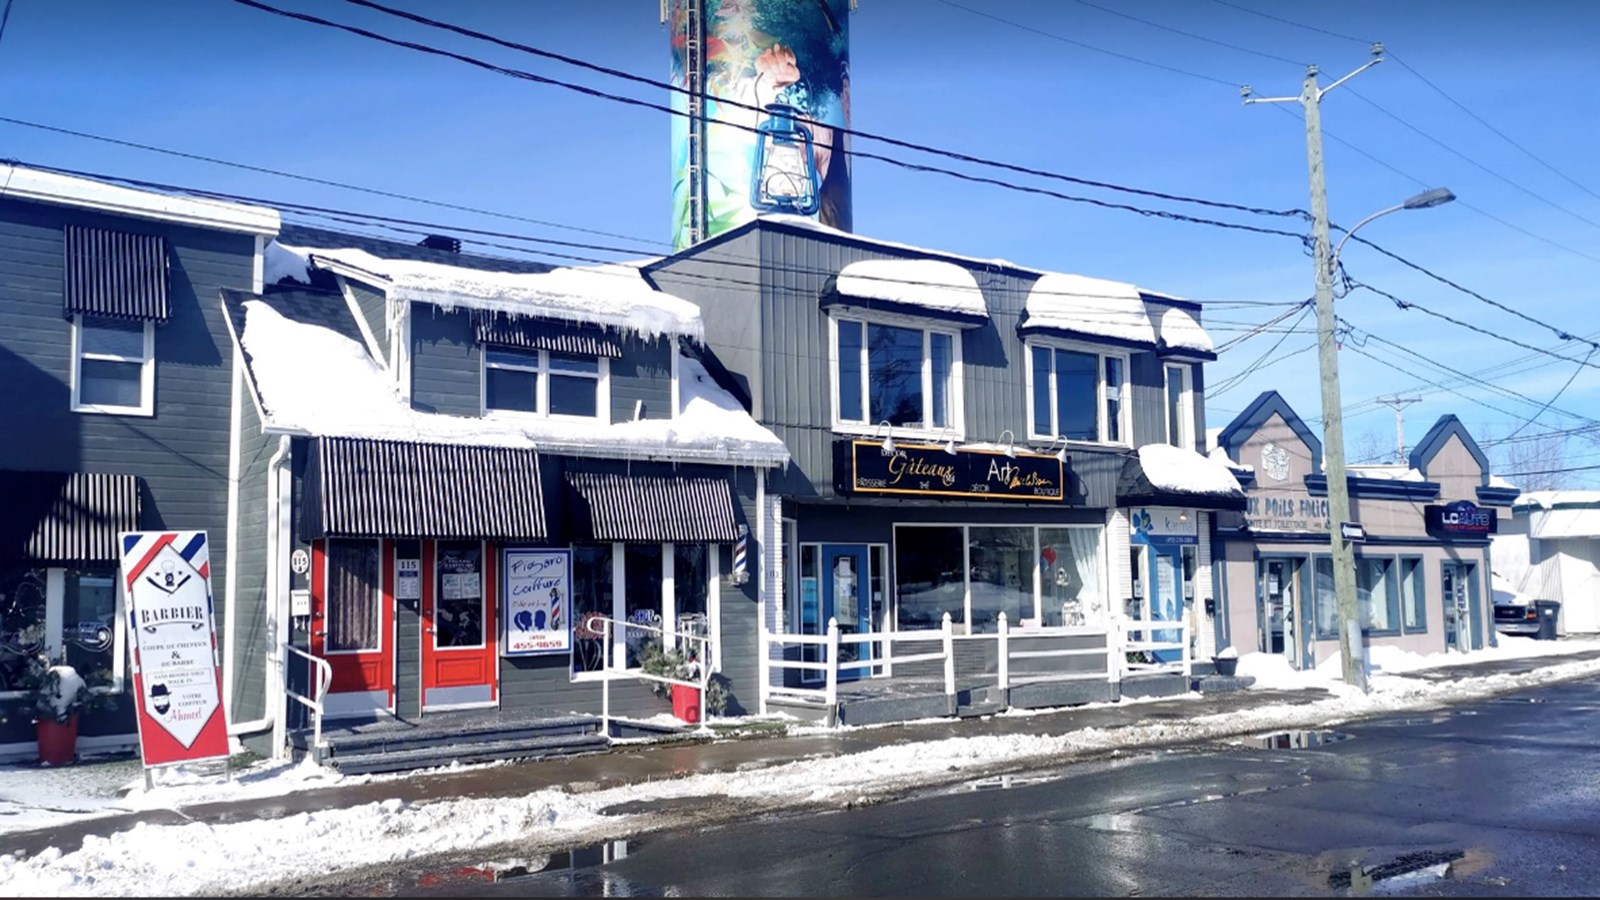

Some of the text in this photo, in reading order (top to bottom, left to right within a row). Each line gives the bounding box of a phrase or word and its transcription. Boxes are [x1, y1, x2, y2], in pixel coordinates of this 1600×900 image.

[888, 453, 954, 484] Gâteaux
[1033, 487, 1060, 496] BOUTIQUE
[1246, 496, 1260, 515] UX
[294, 557, 307, 566] 115
[401, 561, 416, 569] 115
[511, 556, 562, 577] Figaro
[142, 606, 204, 623] BARBIER
[176, 641, 207, 649] CHEVEUX
[171, 651, 181, 659] &
